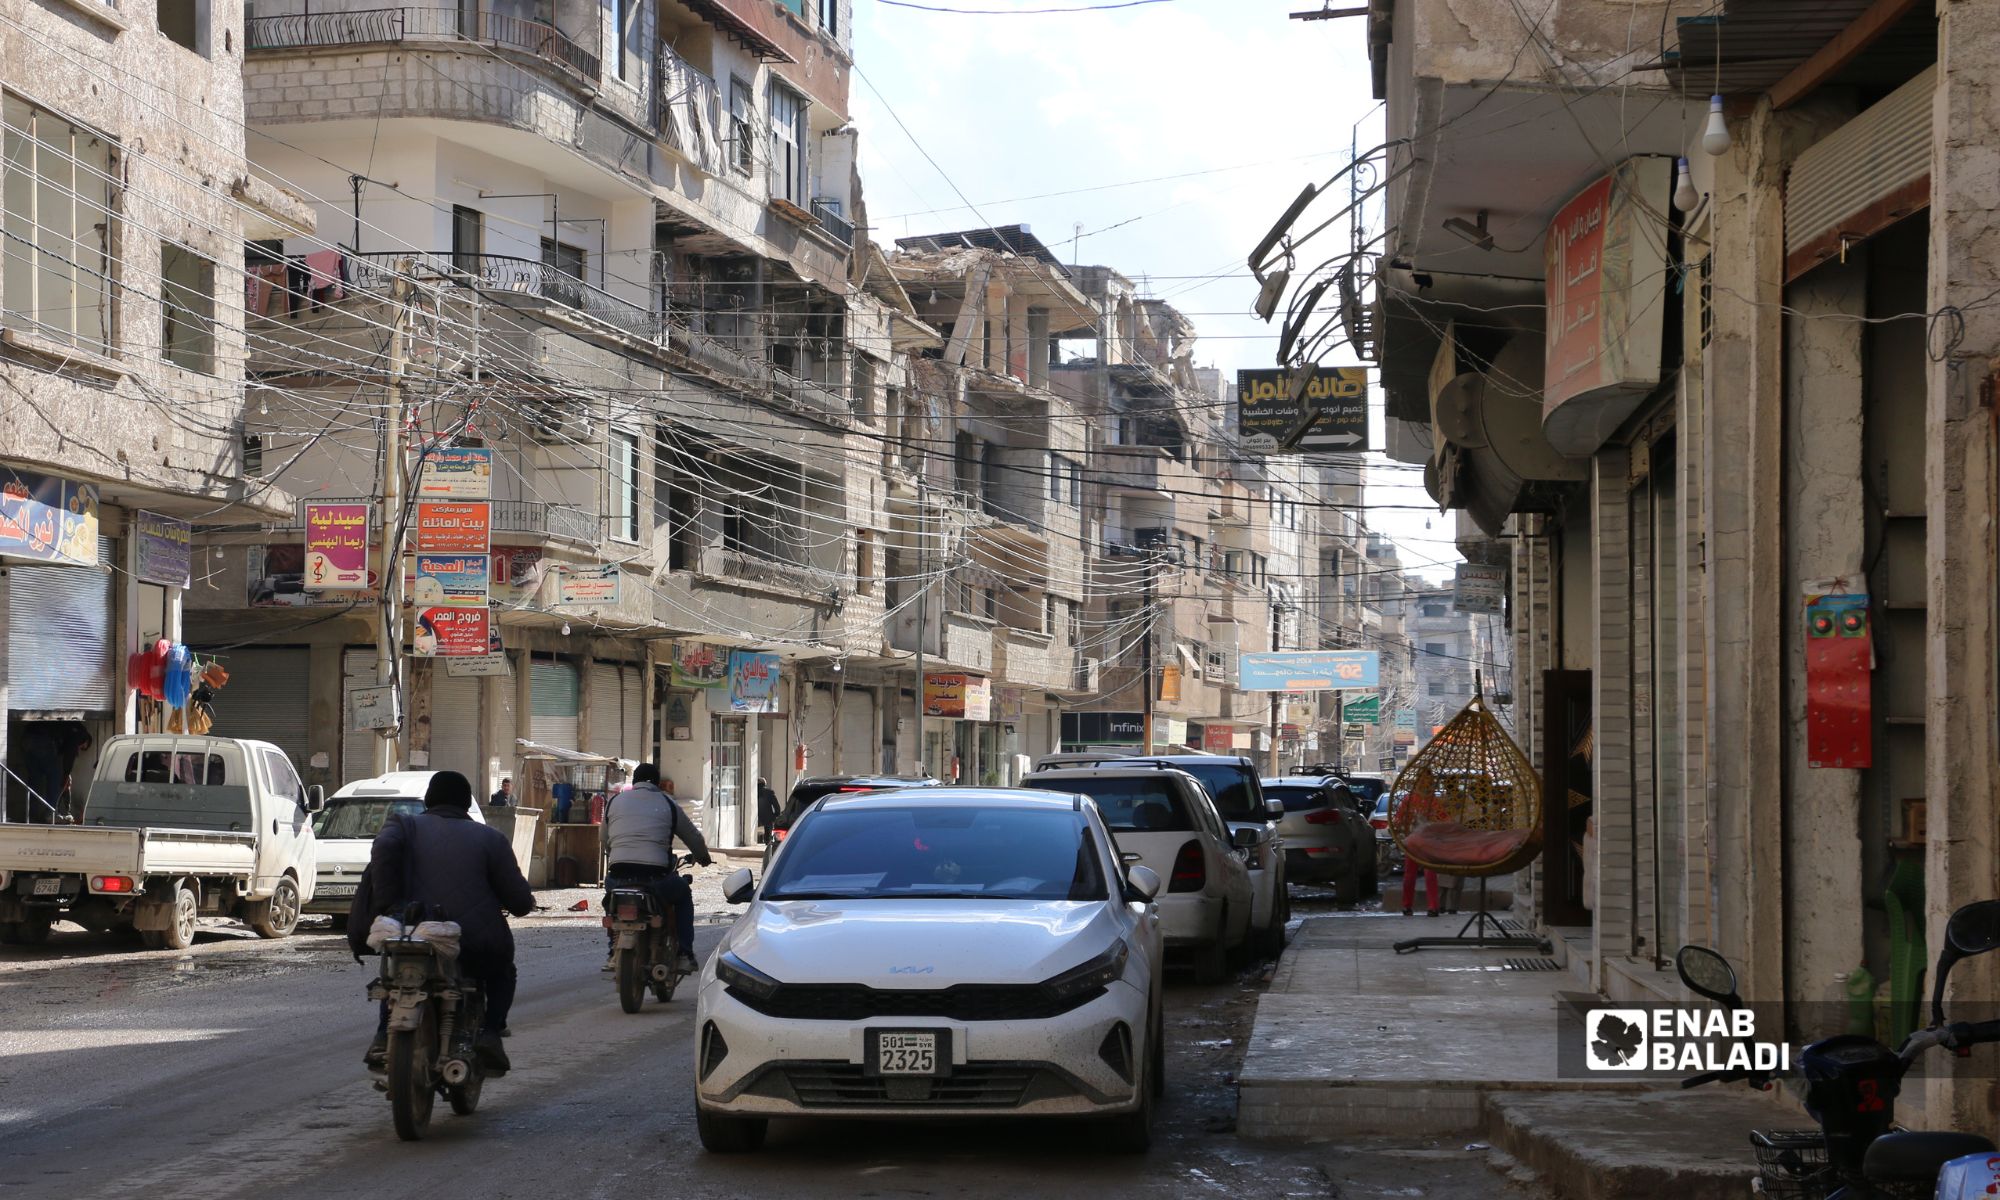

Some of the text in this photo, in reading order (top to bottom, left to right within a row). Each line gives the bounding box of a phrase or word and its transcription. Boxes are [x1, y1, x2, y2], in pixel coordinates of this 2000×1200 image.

[1307, 376, 1363, 399] صالة
[1242, 406, 1274, 416] الخشبية
[309, 507, 365, 530] صيدلية
[422, 517, 484, 531] بيت العائلة
[29, 508, 54, 552] نور
[308, 533, 364, 551] ريما البهنسي
[421, 558, 465, 577] المحبة
[457, 611, 481, 624] فروج
[929, 677, 962, 689] حلويات
[1110, 722, 1145, 733] Infinix
[18, 848, 76, 857] HYUNDAI
[35, 884, 58, 893] 6748
[882, 1036, 904, 1048] 501
[882, 1050, 933, 1071] 2325
